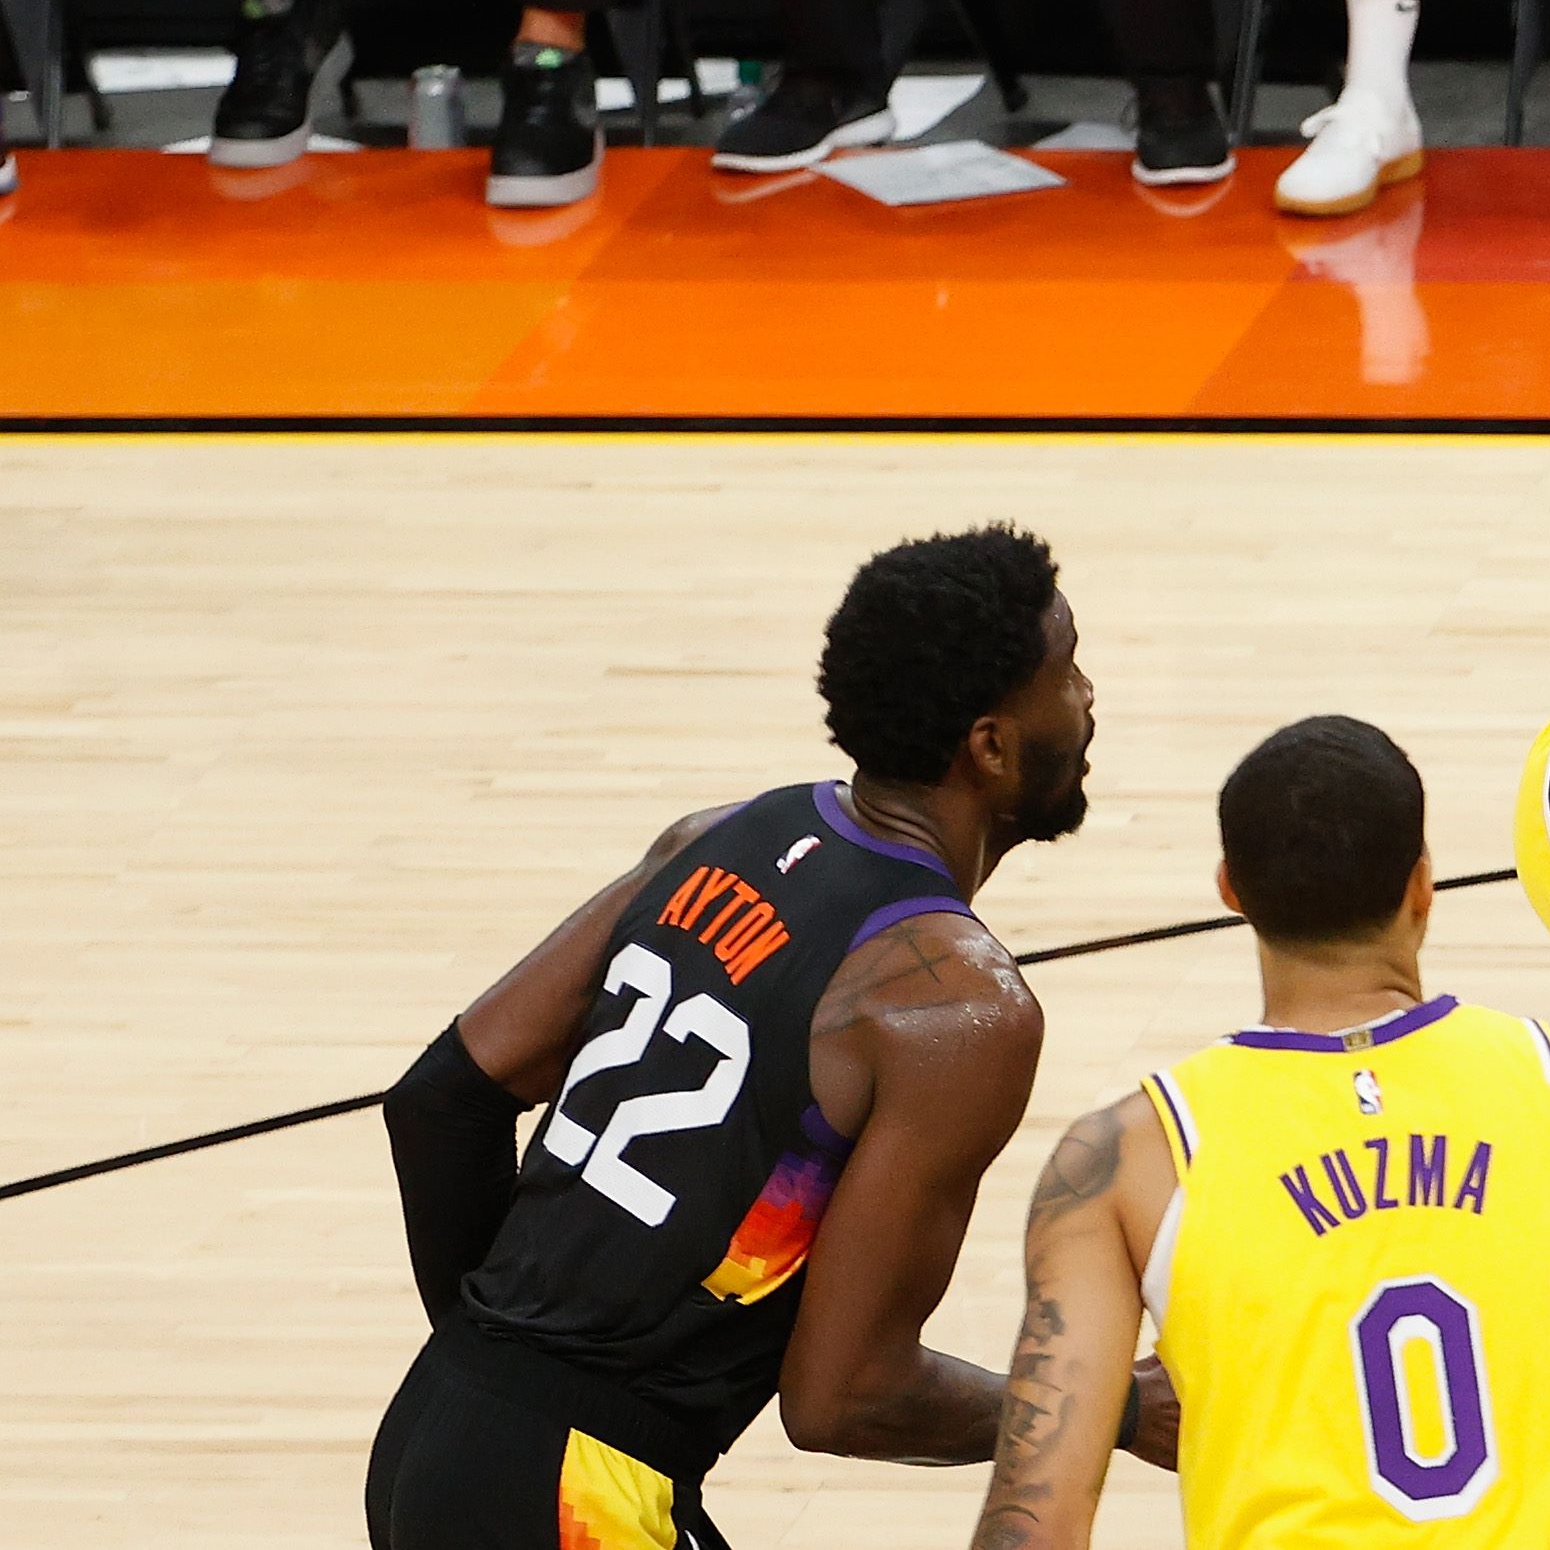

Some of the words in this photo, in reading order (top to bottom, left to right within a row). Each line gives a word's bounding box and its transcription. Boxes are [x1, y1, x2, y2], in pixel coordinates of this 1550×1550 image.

[656, 865, 791, 987] AYTON
[543, 942, 752, 1228] 22
[1280, 1134, 1492, 1237] KUZMA
[1349, 1274, 1500, 1524] 0
